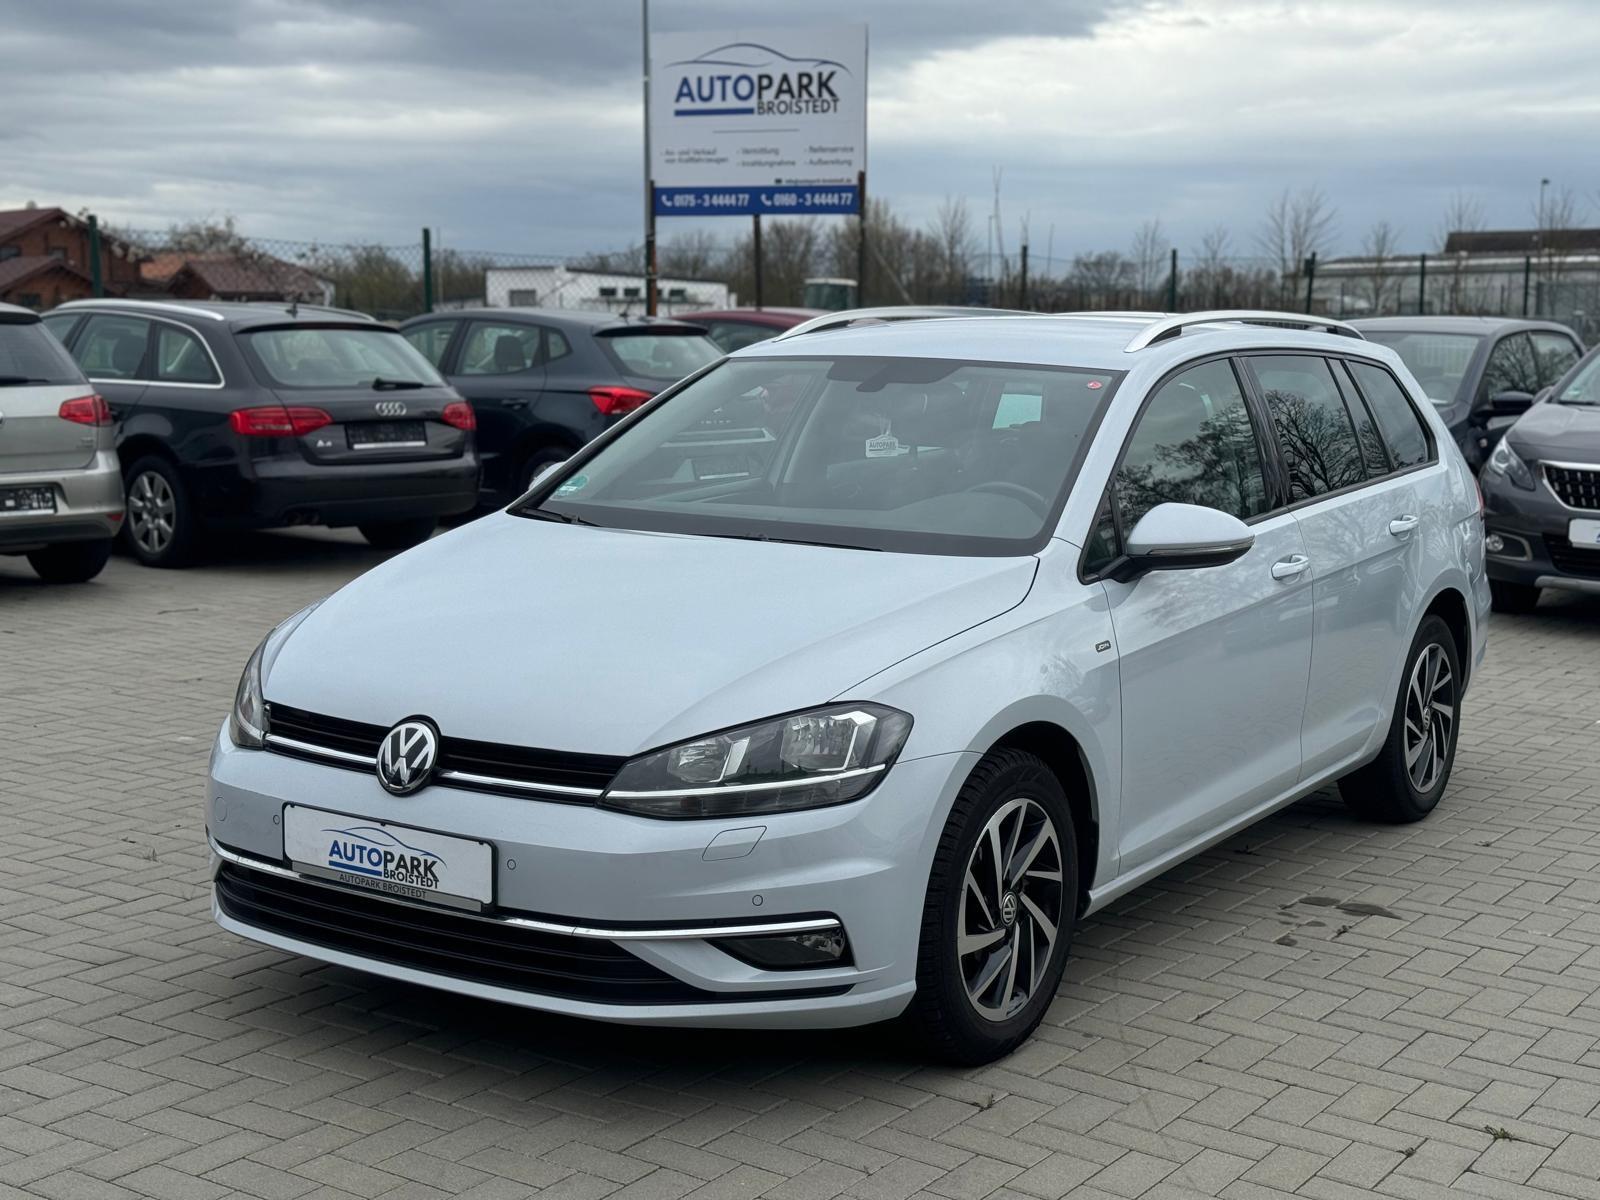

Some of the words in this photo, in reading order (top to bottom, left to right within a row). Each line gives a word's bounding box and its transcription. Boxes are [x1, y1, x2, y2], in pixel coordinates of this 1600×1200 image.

[674, 71, 838, 103] AUTOPARK
[757, 99, 839, 115] BROISTEDT
[328, 839, 440, 882] AUTOPARK
[339, 873, 381, 889] AUTOPARK
[382, 882, 428, 899] BROISTEDT
[383, 867, 440, 889] BROISTEDT
